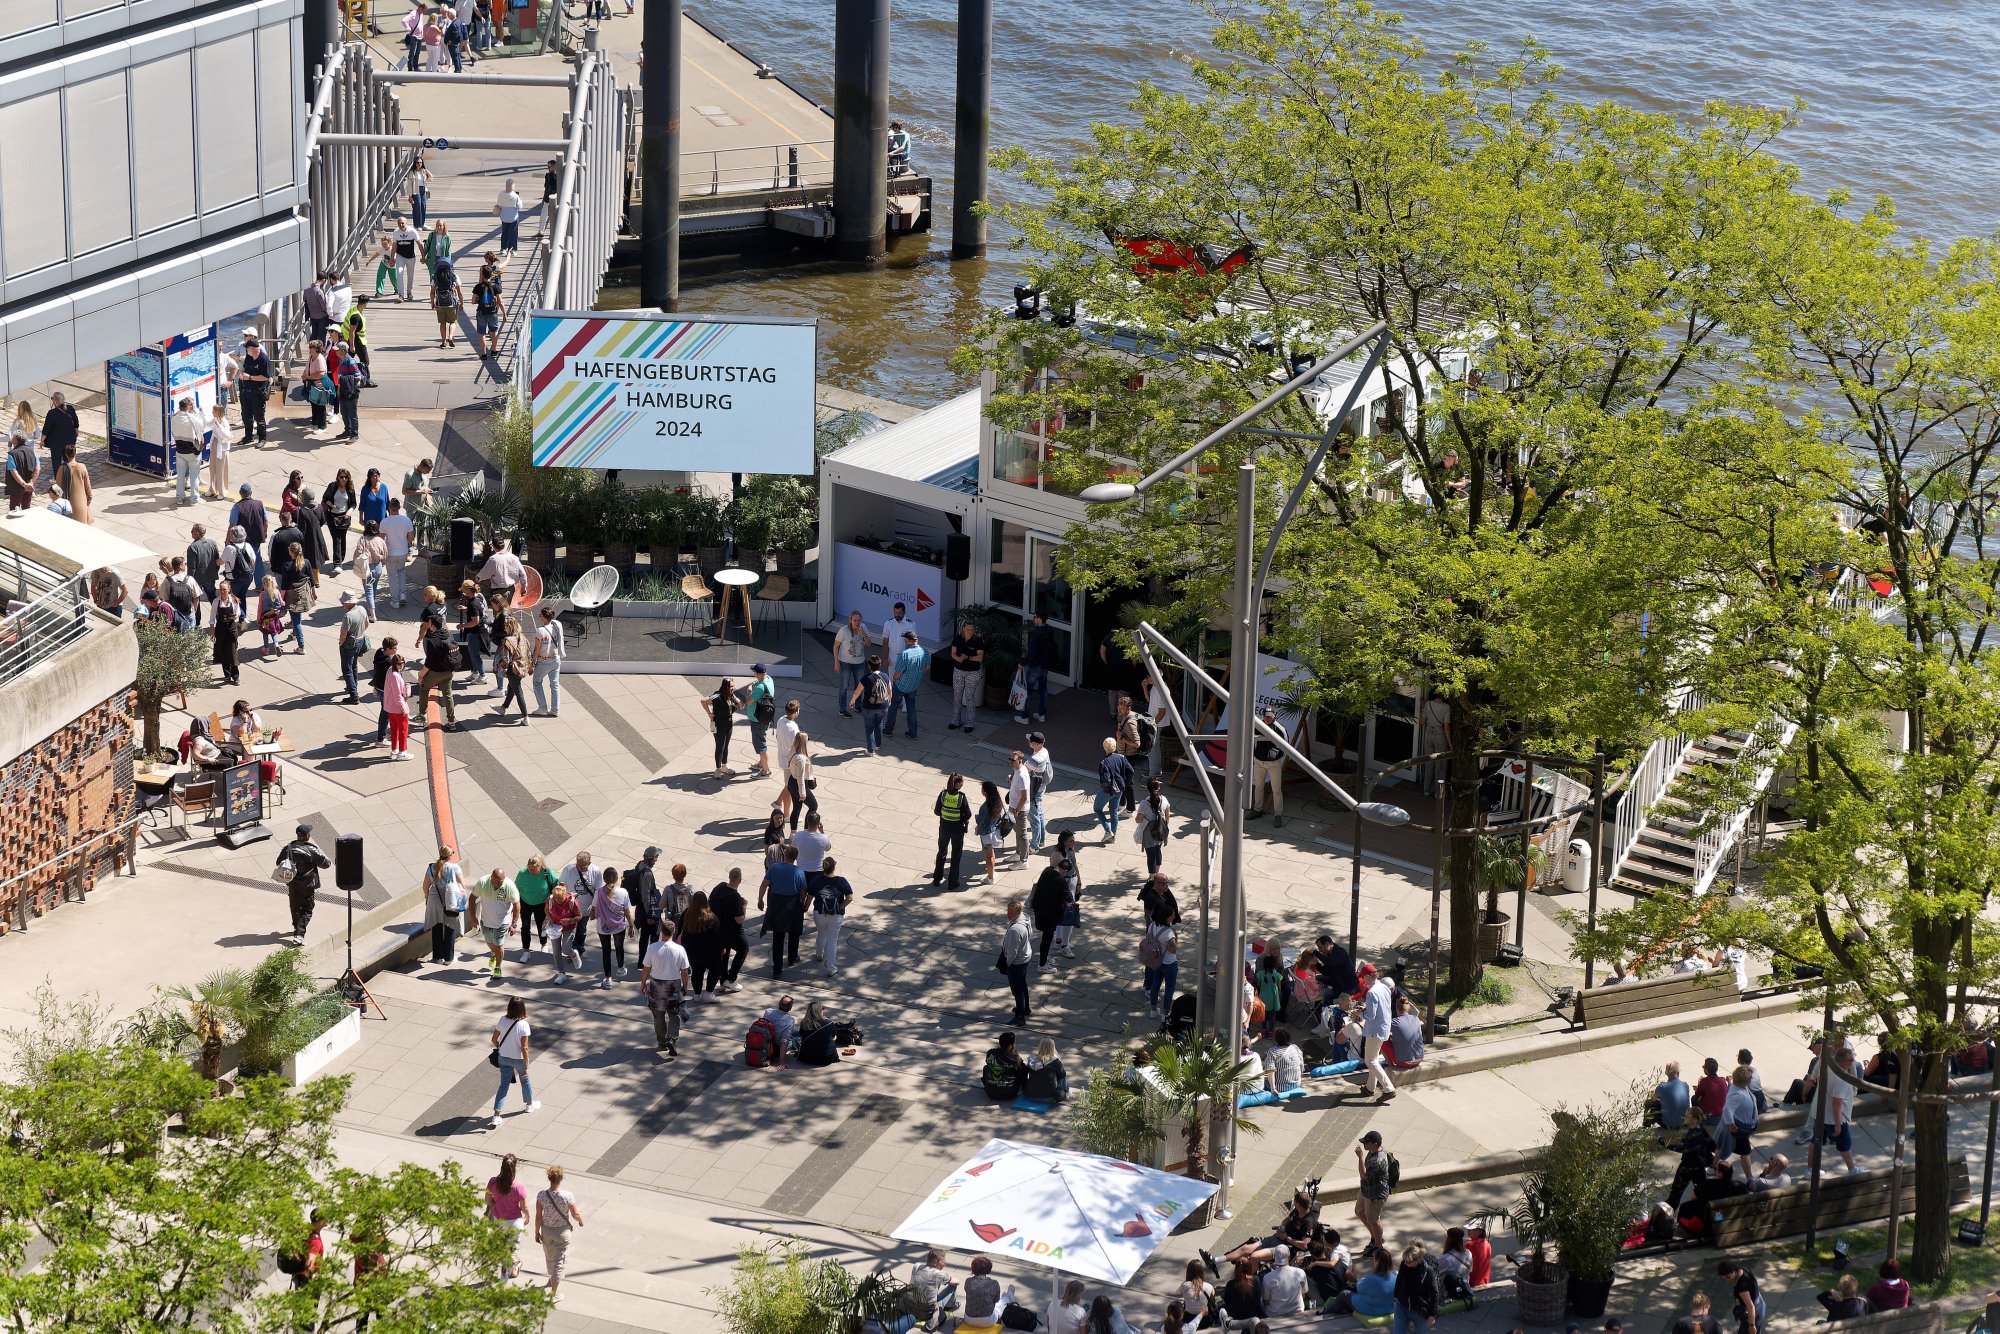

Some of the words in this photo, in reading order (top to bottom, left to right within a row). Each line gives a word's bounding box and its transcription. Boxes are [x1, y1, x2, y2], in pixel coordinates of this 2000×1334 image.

[574, 361, 777, 384] HAFENGEBURTSTAG
[626, 391, 732, 410] HAMBURG
[655, 420, 703, 438] 2024
[1148, 1199, 1182, 1225] AIDA
[1008, 1236, 1064, 1260] AIDA
